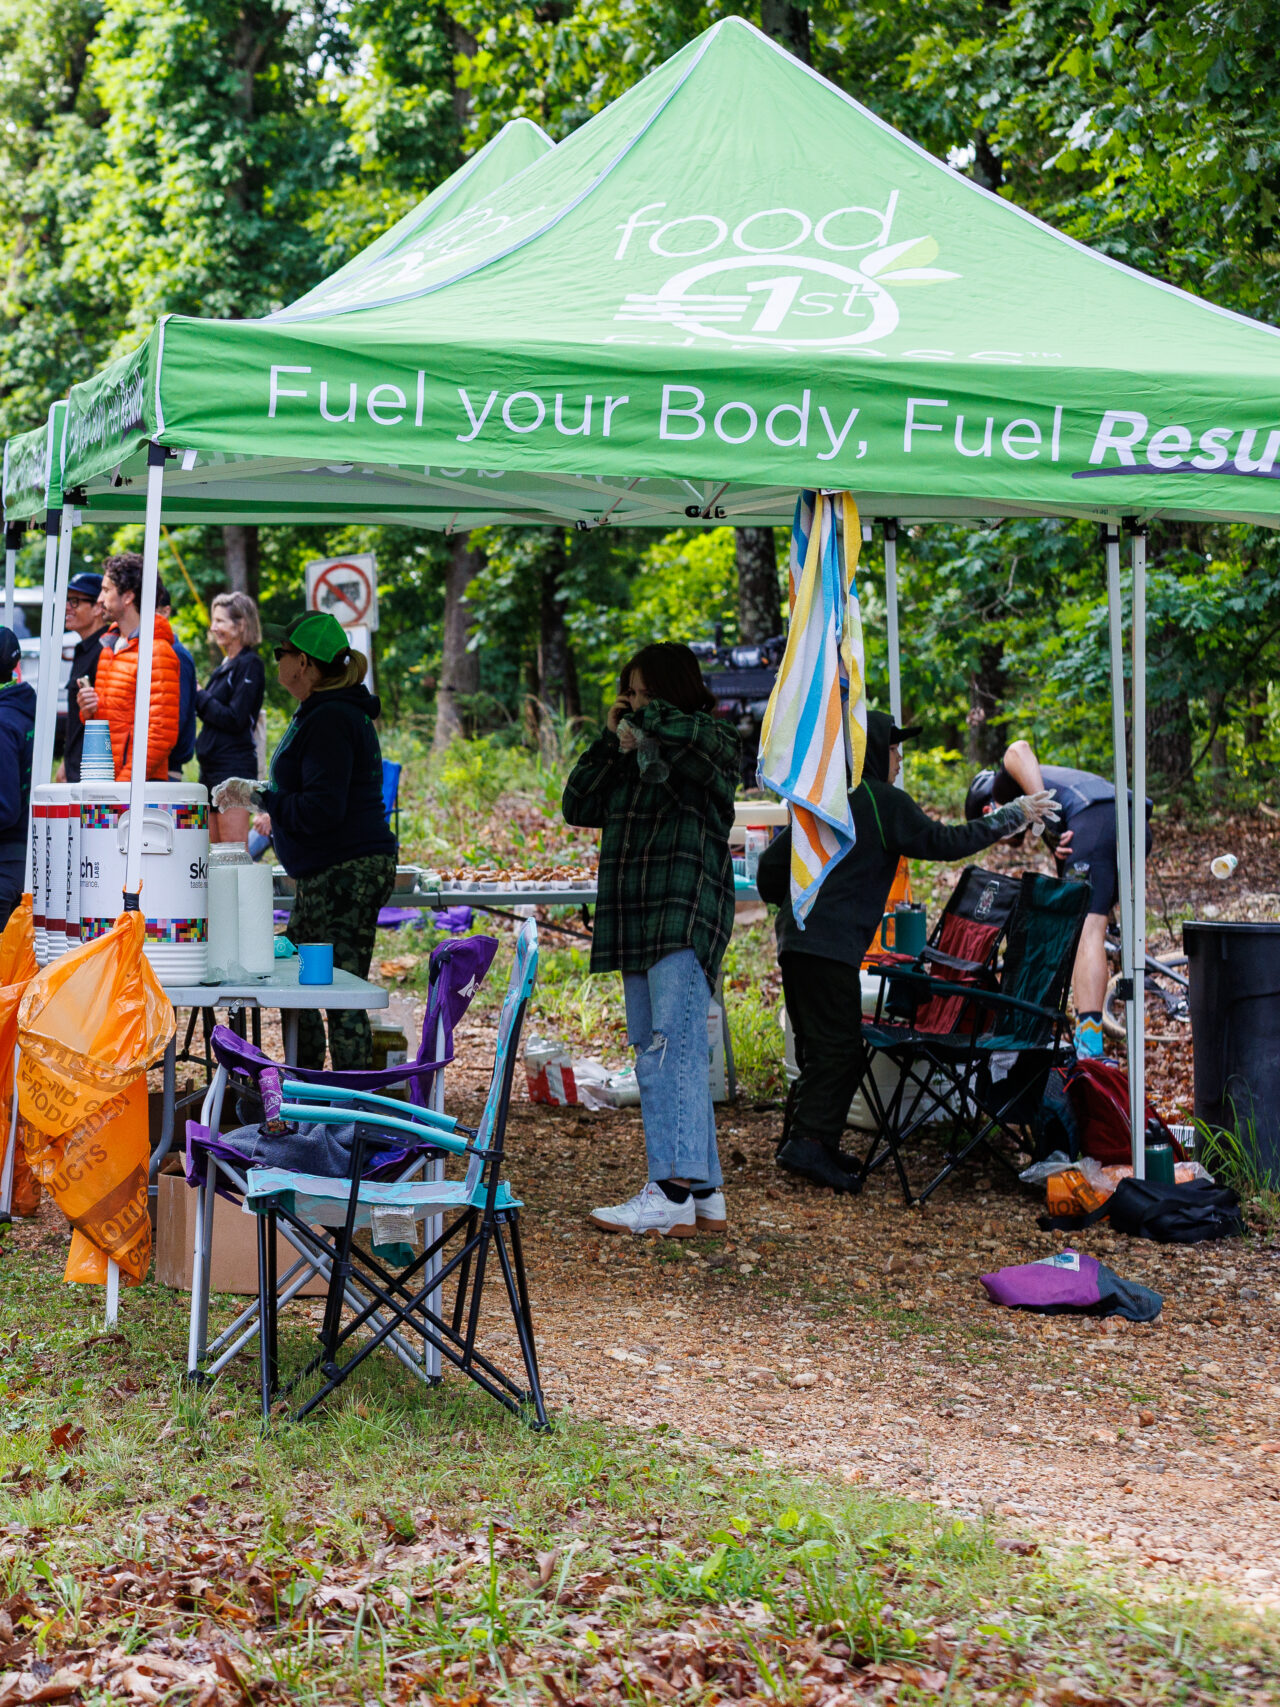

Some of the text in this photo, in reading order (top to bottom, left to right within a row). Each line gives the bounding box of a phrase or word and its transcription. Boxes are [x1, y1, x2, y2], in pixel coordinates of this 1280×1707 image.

[614, 188, 900, 261] food
[267, 363, 1280, 473] Fuel your Body, Fuel Resu
